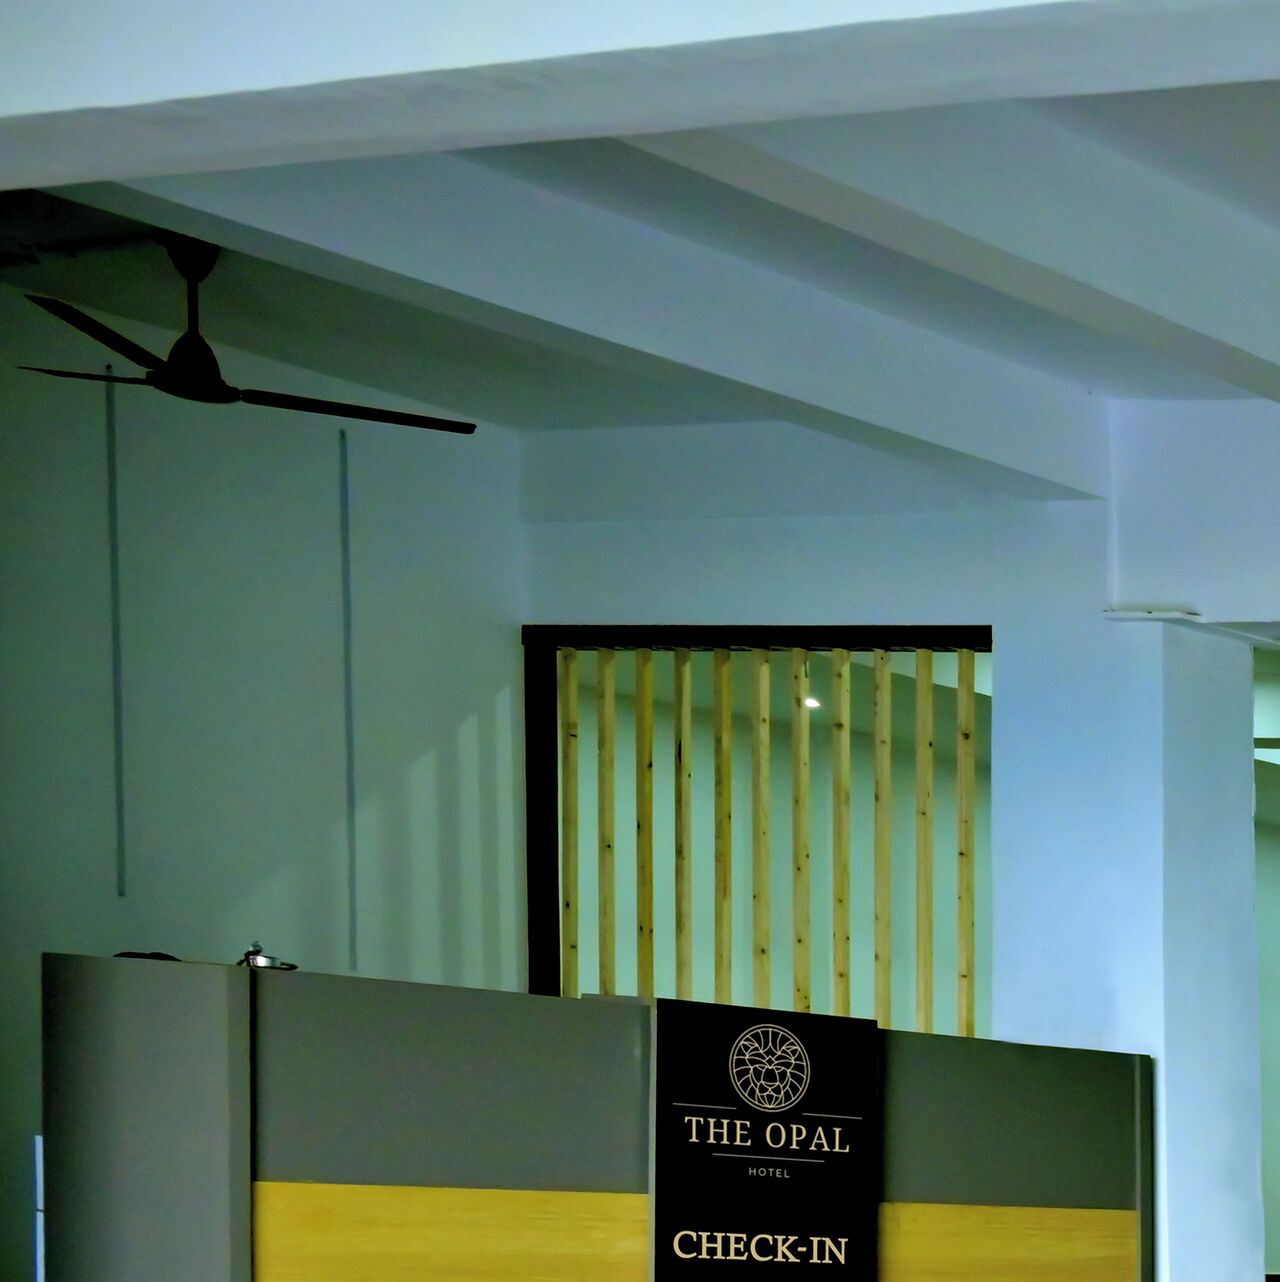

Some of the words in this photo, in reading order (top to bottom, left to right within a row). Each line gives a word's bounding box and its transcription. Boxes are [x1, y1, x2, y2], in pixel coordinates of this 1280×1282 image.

[684, 1116, 751, 1146] THE
[765, 1122, 850, 1153] OPAL
[748, 1167, 790, 1178] HOTEL
[672, 1230, 849, 1265] CHECK-IN
